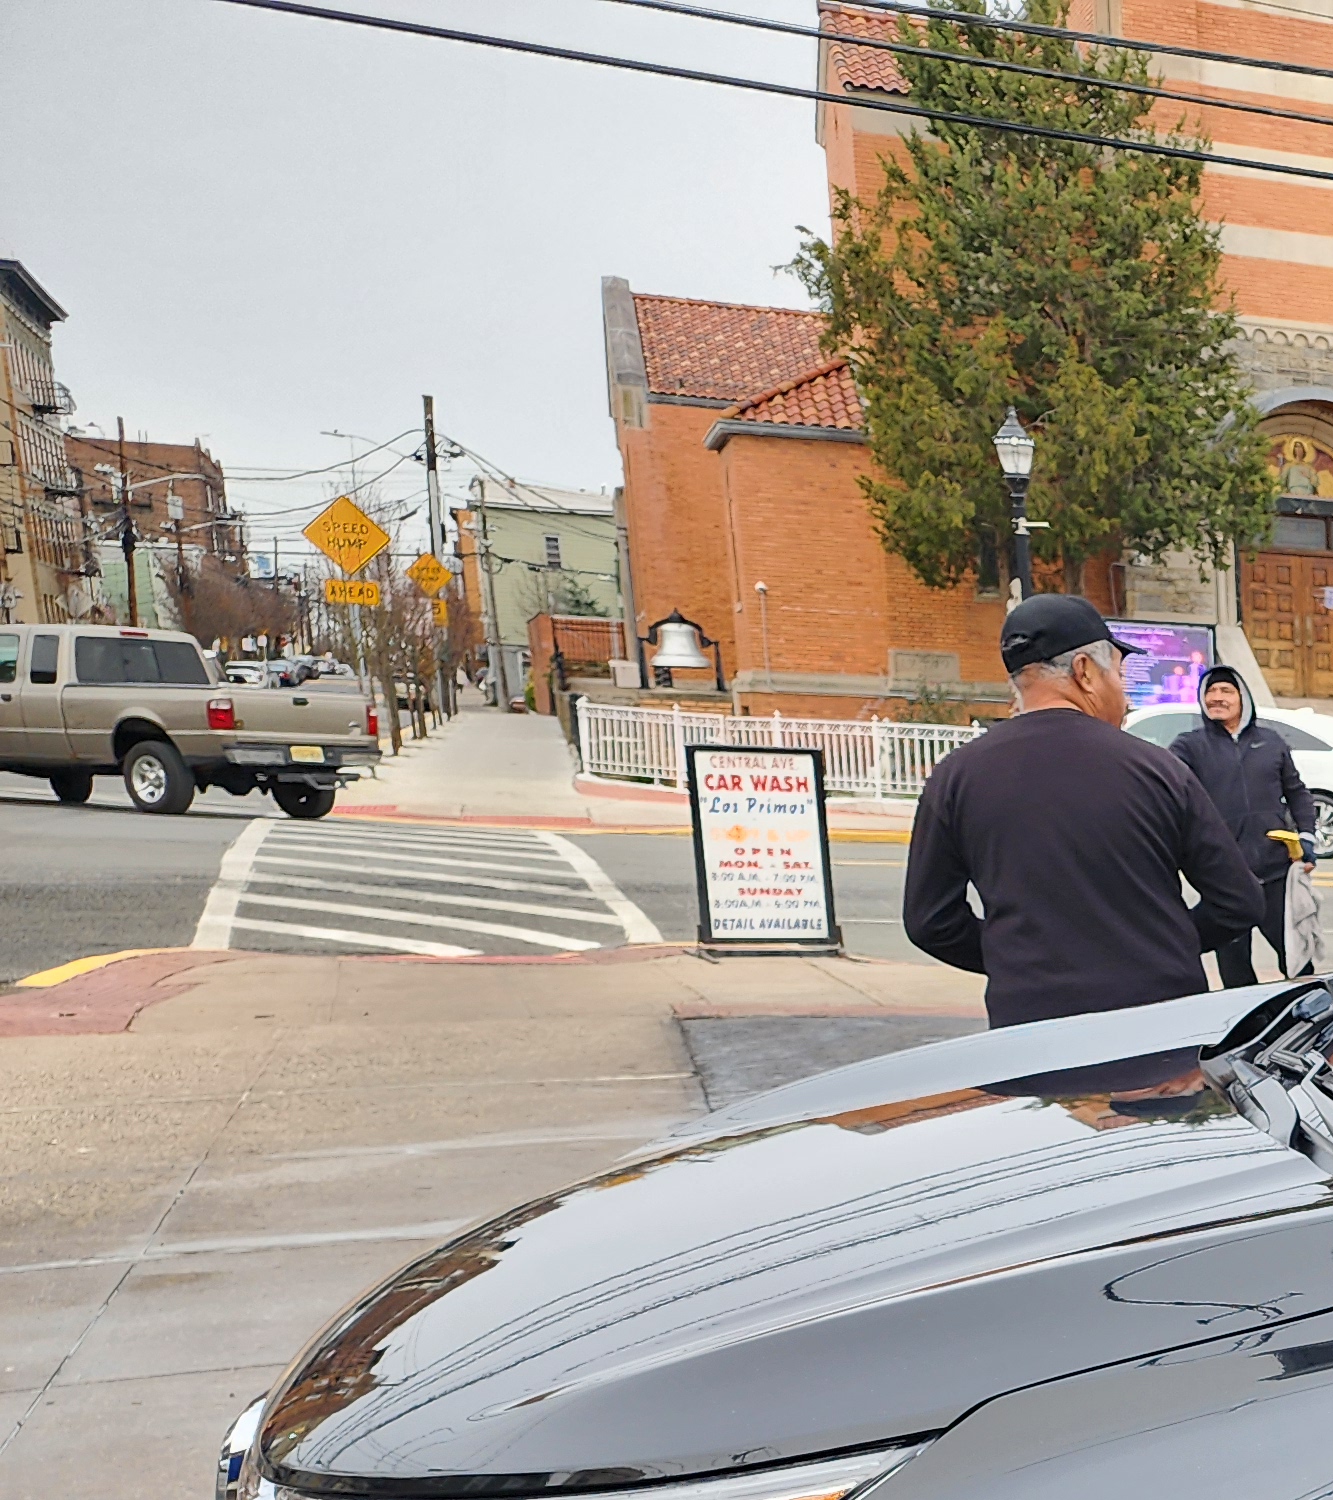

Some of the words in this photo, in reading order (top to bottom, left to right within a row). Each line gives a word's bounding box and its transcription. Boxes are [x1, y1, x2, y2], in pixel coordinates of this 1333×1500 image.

[322, 521, 369, 535] SPEED
[327, 536, 367, 549] HUMP
[330, 585, 375, 598] AHEAD
[709, 755, 766, 769] CENTRAL
[704, 774, 743, 791] CAR
[749, 774, 809, 793] WASH
[738, 887, 803, 896] SUNDAY
[714, 918, 755, 931] DETAIL
[759, 918, 823, 931] AVAILABLE
